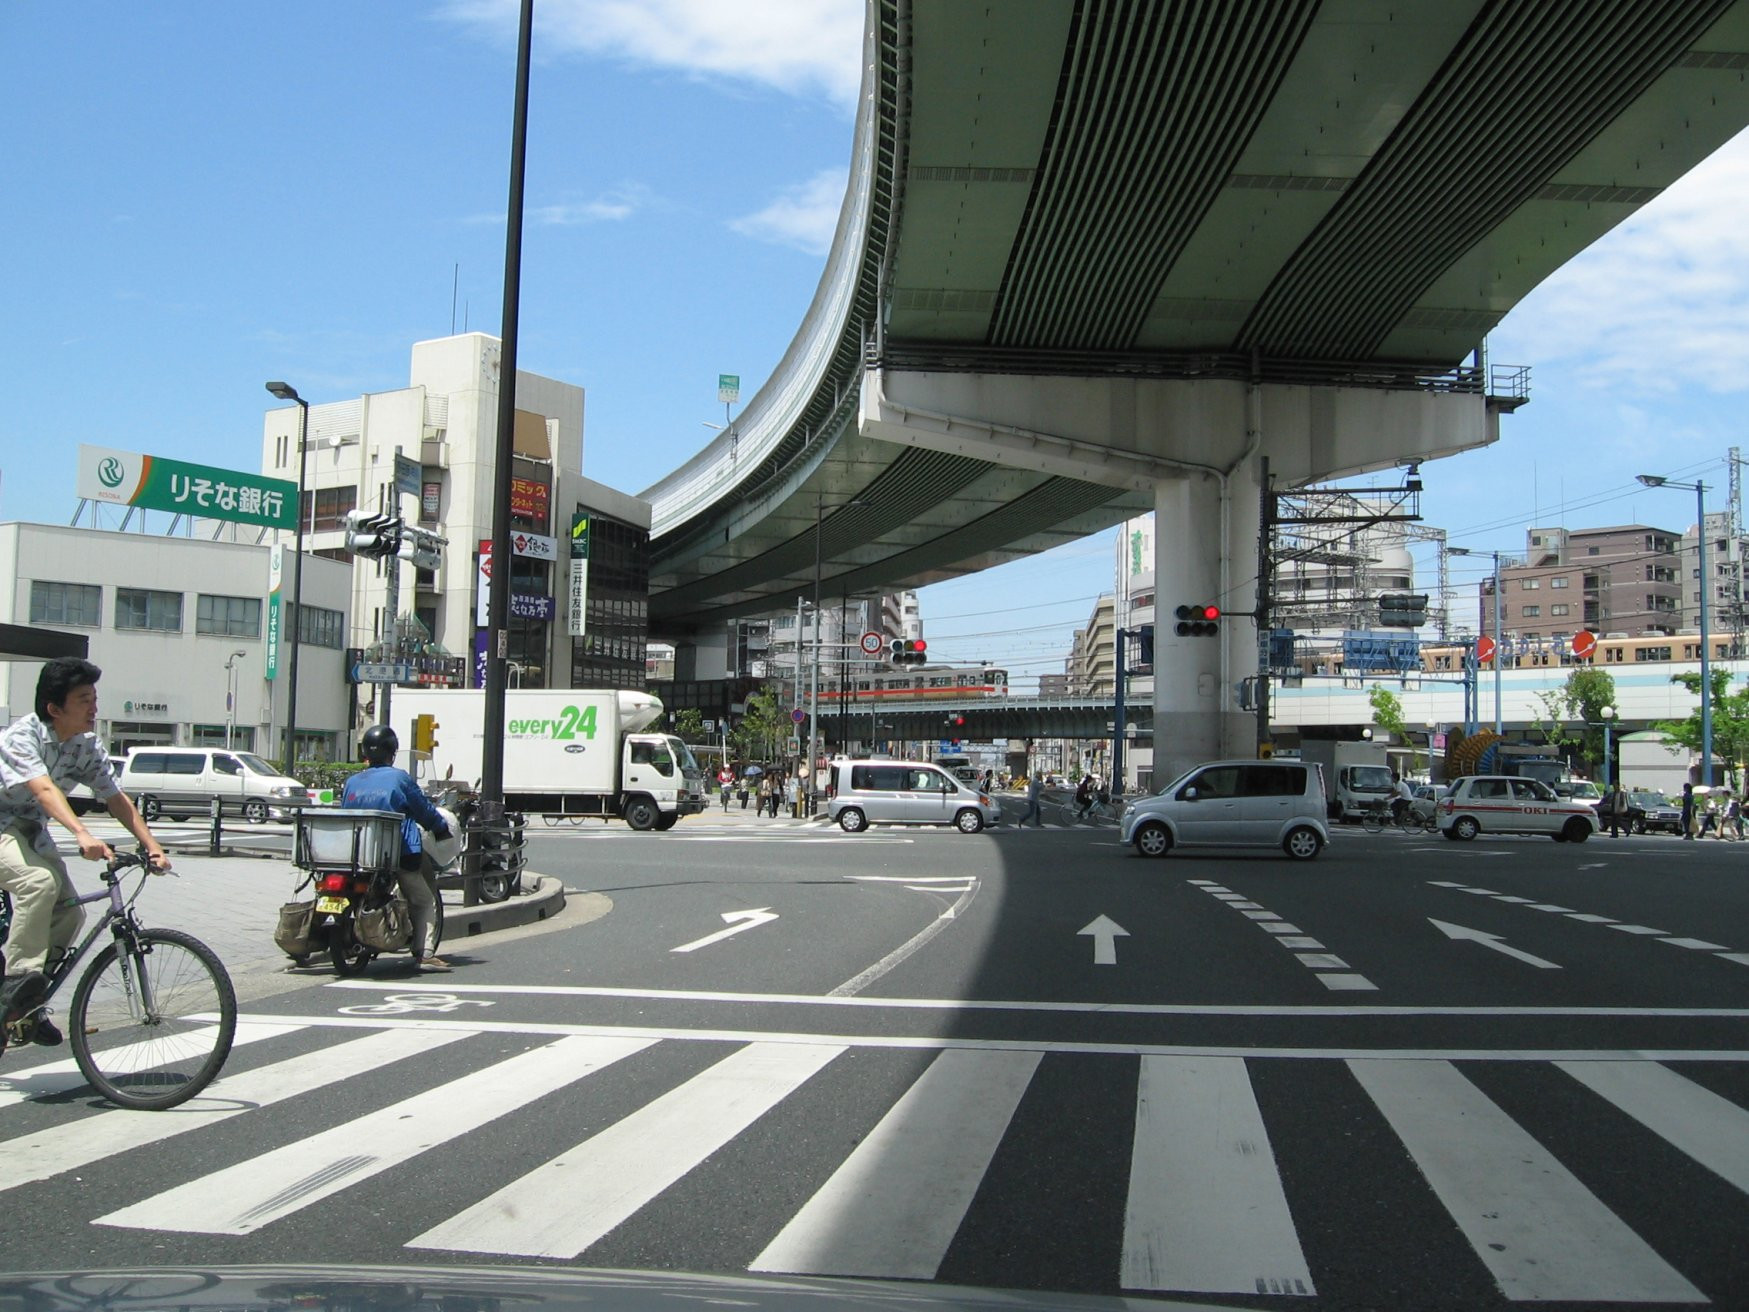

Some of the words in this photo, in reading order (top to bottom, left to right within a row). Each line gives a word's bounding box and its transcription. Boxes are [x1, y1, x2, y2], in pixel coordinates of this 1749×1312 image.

[171, 474, 283, 518] りそな銀行
[572, 563, 583, 631] 三井住友銀行
[268, 605, 277, 670] りそな銀行
[865, 637, 878, 648] 50
[134, 702, 168, 712] りそな銀行
[508, 705, 598, 740] every24
[1523, 806, 1548, 815] OKI
